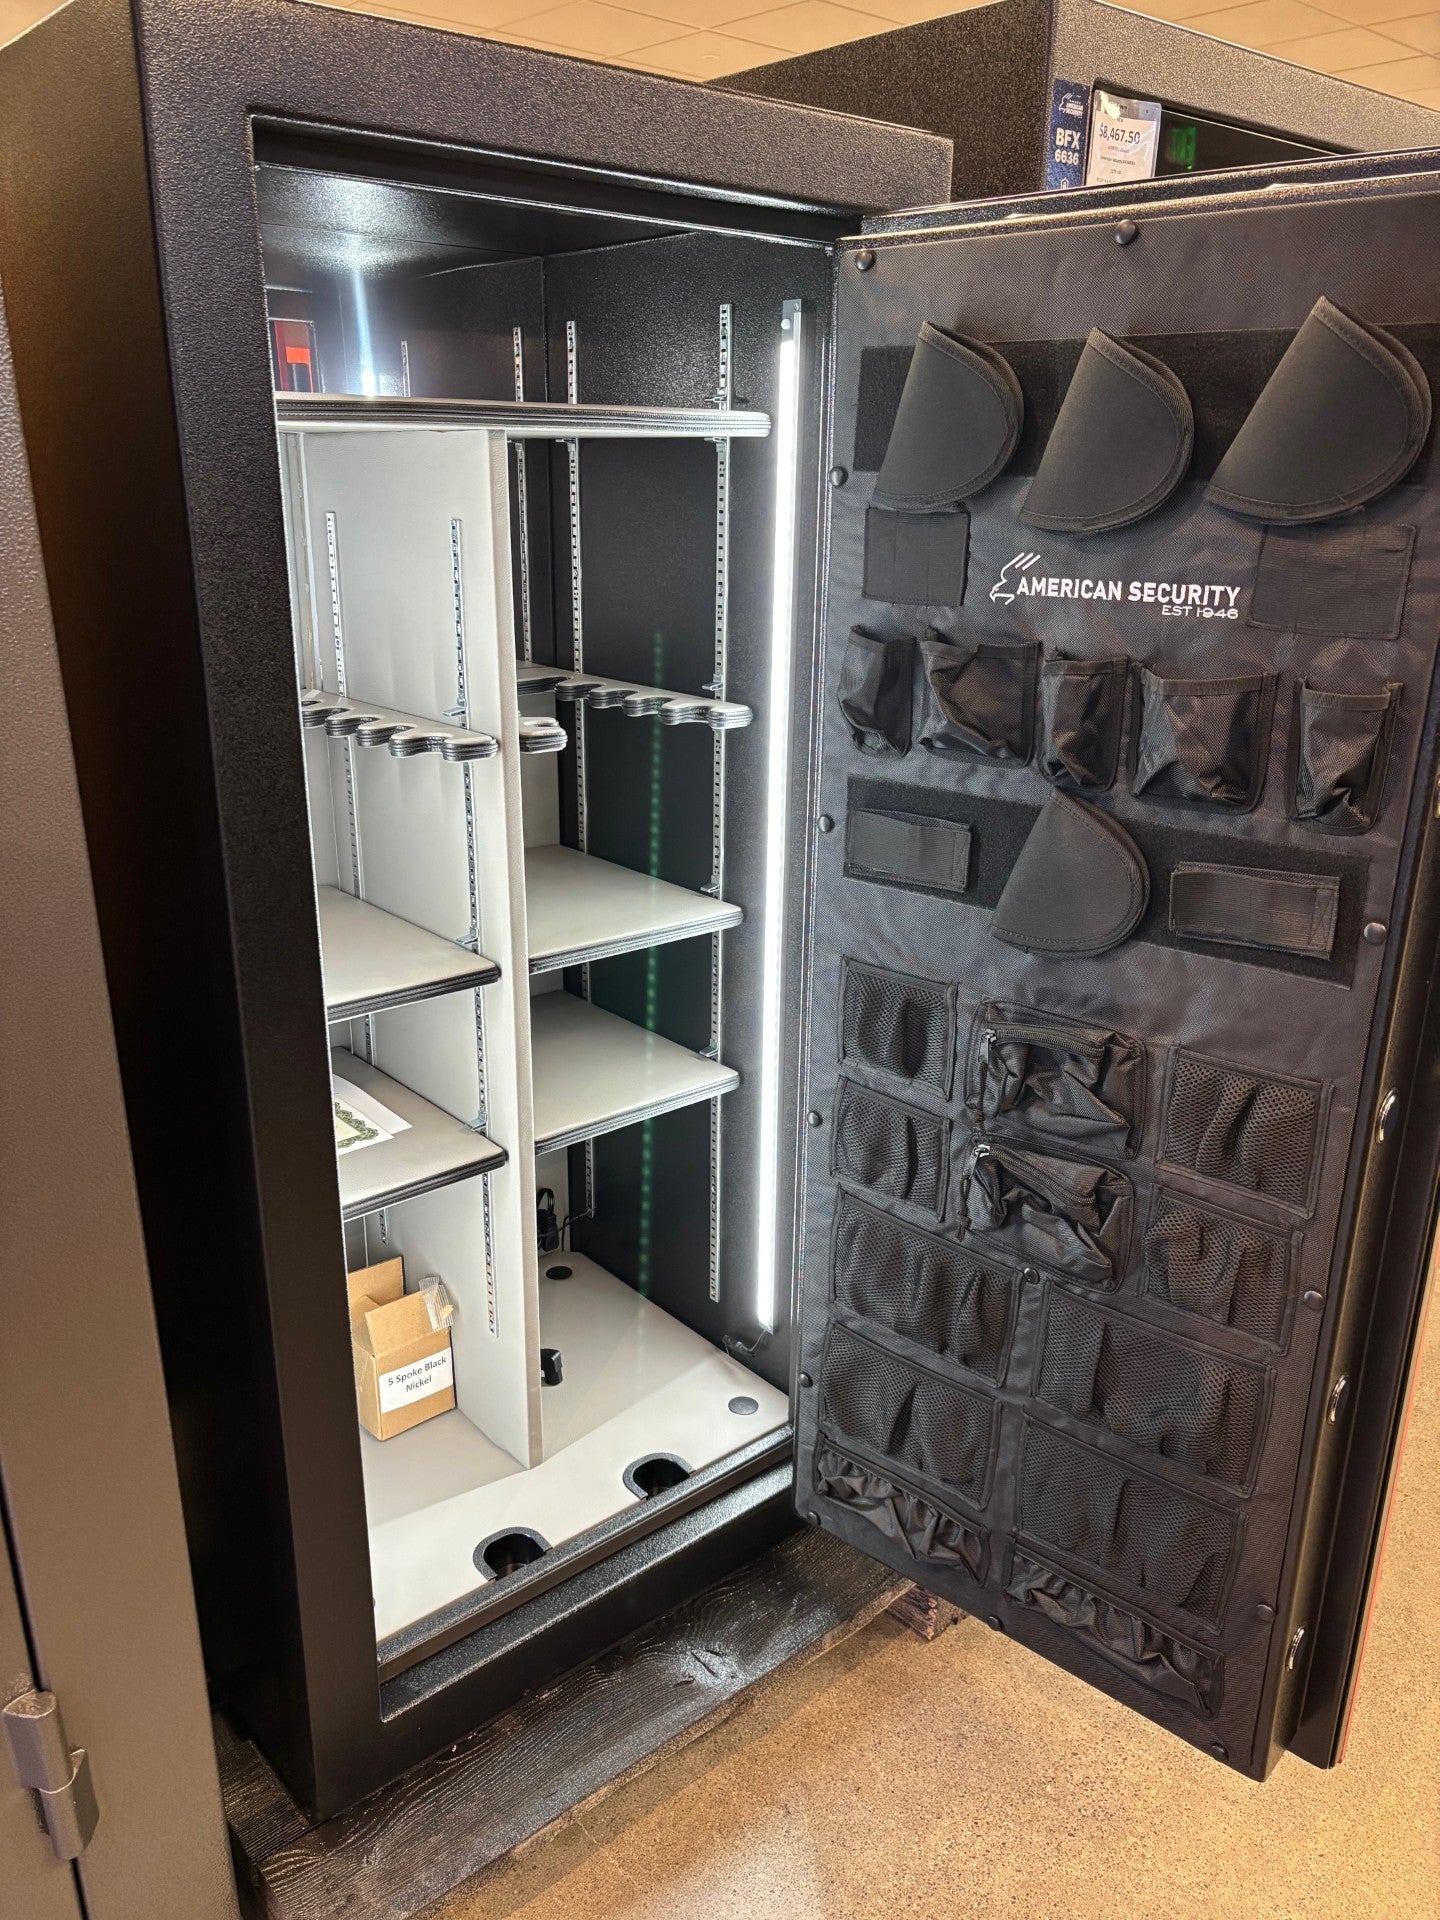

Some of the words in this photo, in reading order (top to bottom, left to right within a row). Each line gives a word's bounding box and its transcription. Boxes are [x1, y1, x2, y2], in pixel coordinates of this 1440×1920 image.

[1055, 127, 1081, 150] BFX
[1098, 122, 1141, 145] $8,467.50
[1054, 148, 1080, 166] 6636
[1016, 576, 1122, 601] AMERICAN
[1127, 581, 1241, 607] SECURITY
[1161, 605, 1193, 617] EST
[1196, 607, 1239, 620] 1946
[387, 1377, 394, 1387] 5
[395, 1367, 423, 1384] Spoke
[424, 1356, 447, 1372] Black
[405, 1374, 432, 1393] Nickel
